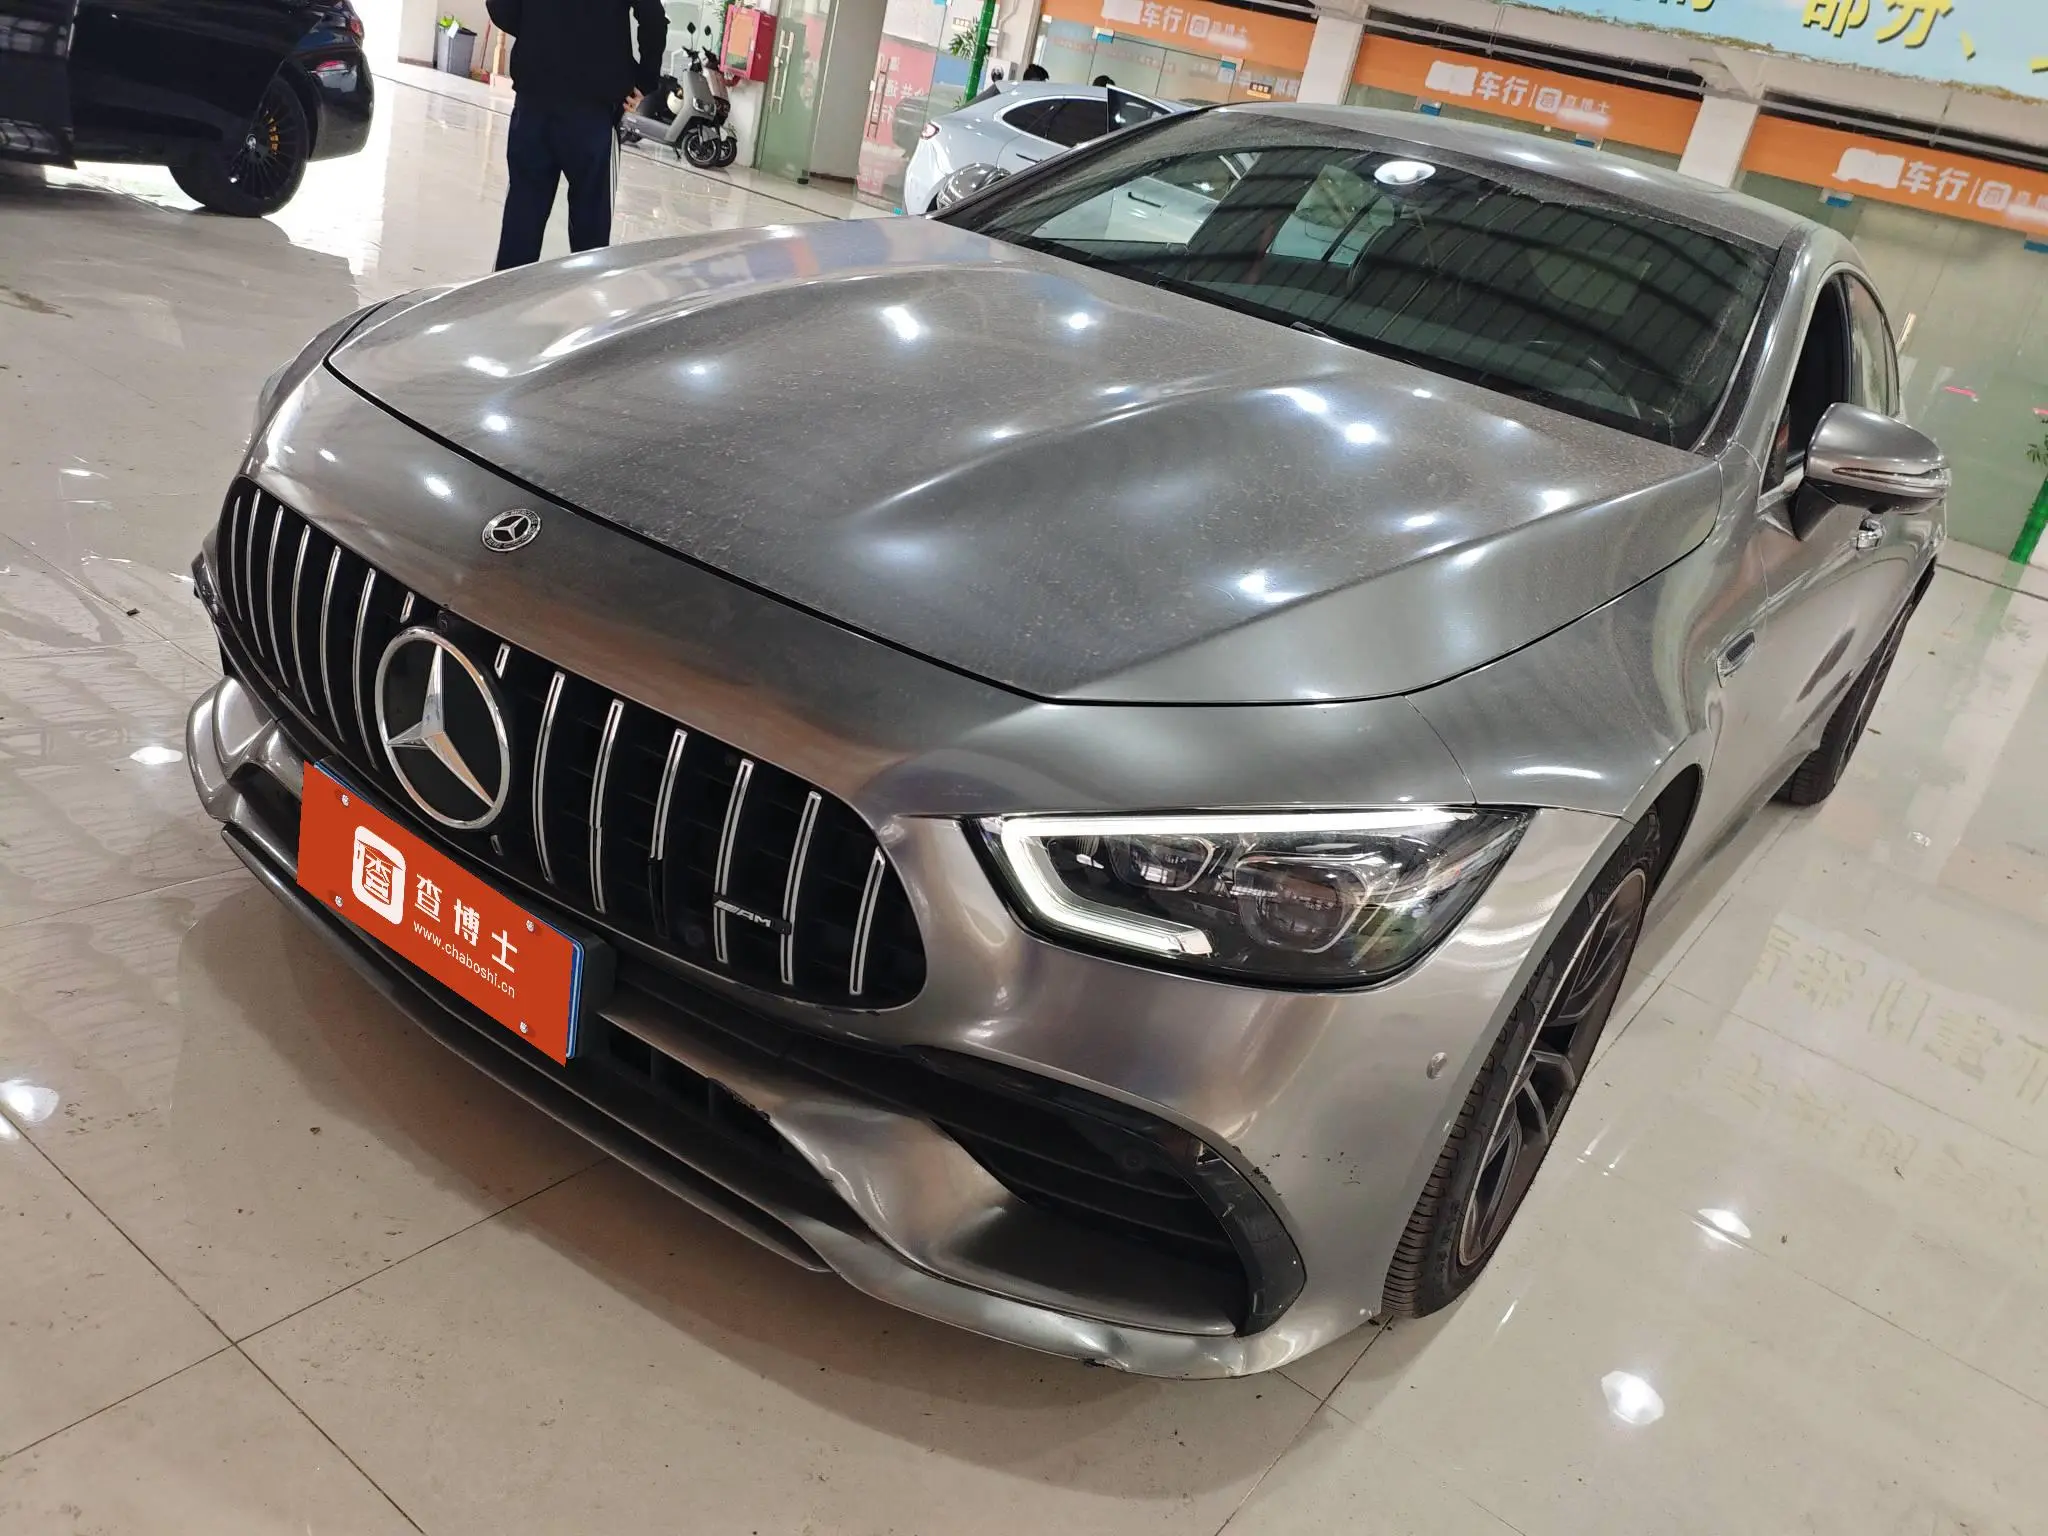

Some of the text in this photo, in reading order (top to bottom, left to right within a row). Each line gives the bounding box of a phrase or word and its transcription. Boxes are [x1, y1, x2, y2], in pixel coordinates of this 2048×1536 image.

[1142, 3, 1184, 33] 车行
[1476, 71, 1530, 107] 车行
[1902, 161, 1971, 202] 车行
